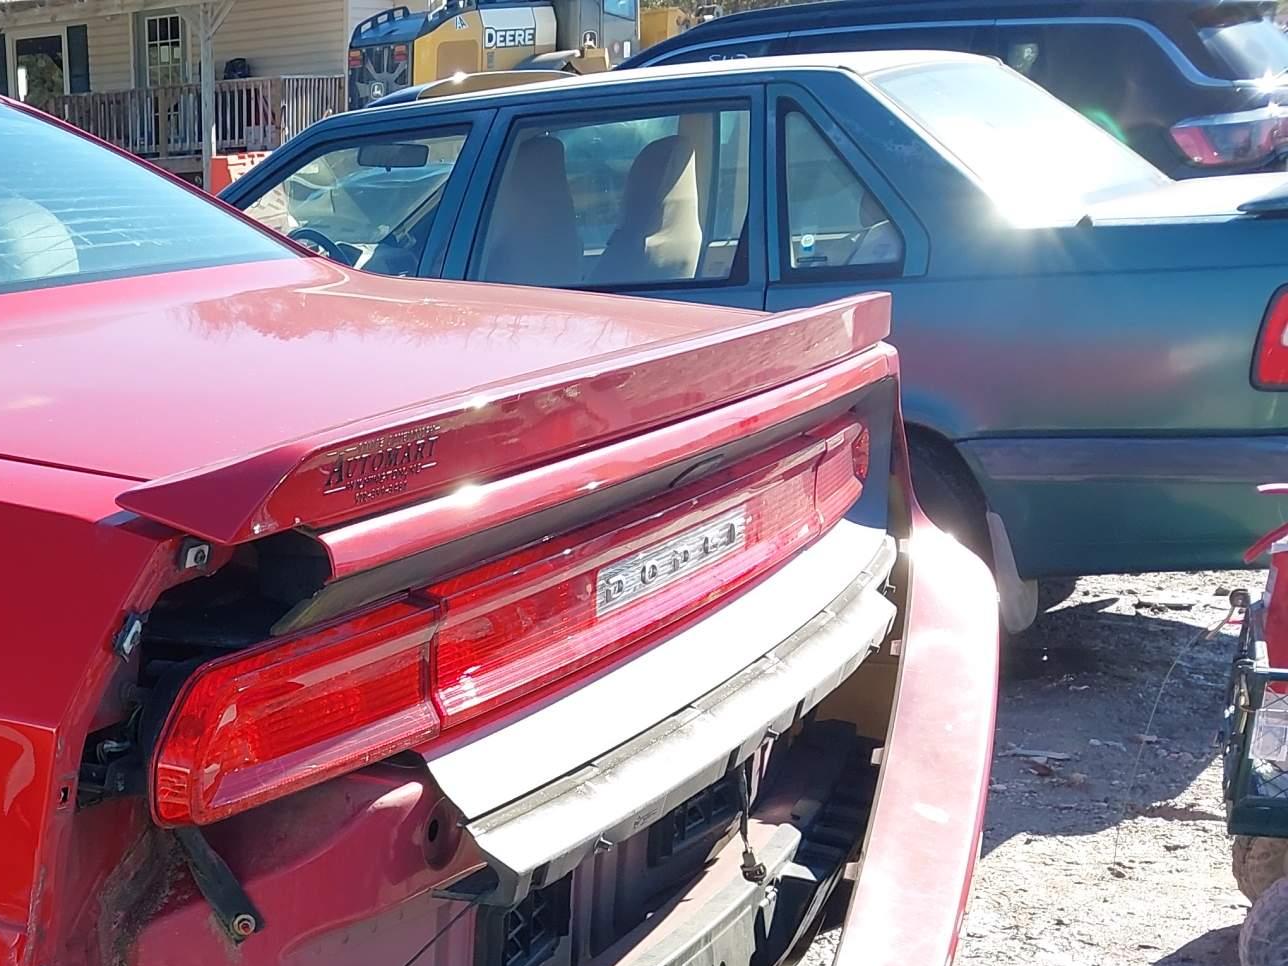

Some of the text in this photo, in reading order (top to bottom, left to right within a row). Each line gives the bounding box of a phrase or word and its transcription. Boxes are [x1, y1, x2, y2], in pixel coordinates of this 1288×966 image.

[485, 28, 535, 48] DEERE
[325, 436, 440, 486] AUTOMART
[604, 522, 736, 604] DODGE
